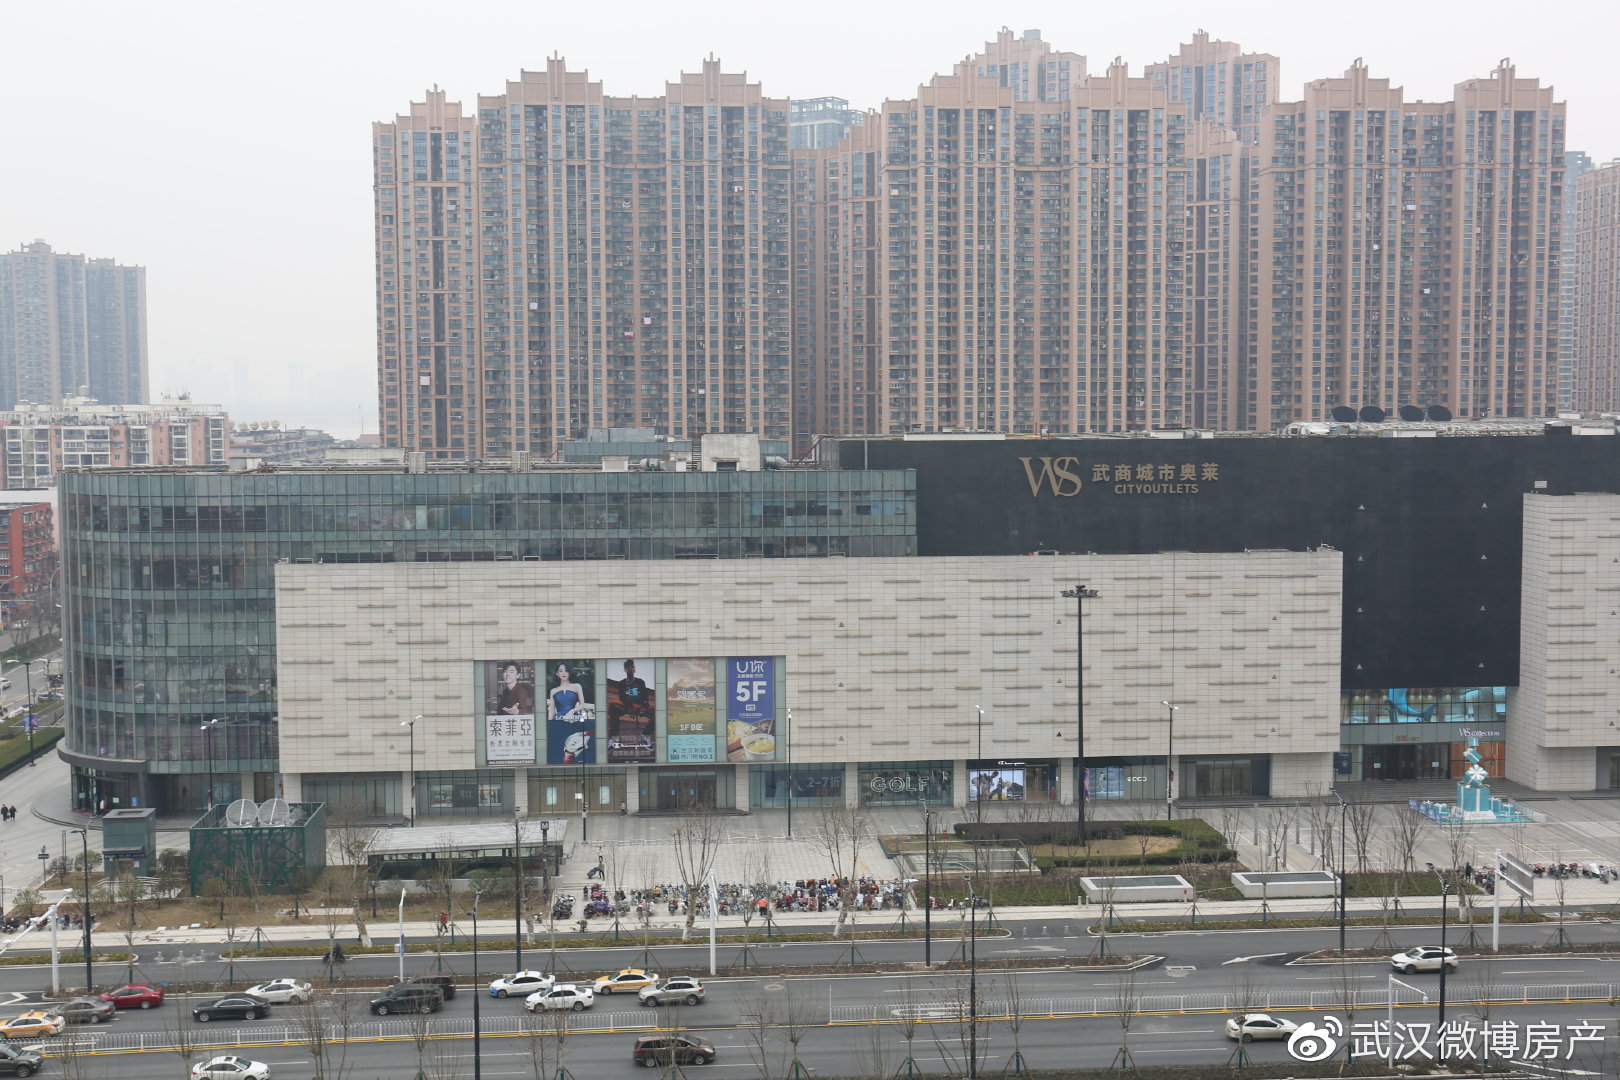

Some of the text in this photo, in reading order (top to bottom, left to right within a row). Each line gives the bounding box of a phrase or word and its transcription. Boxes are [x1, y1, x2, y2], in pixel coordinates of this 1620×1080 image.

[1018, 456, 1082, 497] WS
[1091, 462, 1219, 483] 武商城市奥莱
[1114, 484, 1199, 494] CITYOUTLETS
[736, 680, 767, 702] 5F
[489, 718, 532, 737] 索菲亞
[870, 776, 930, 792] GOLF
